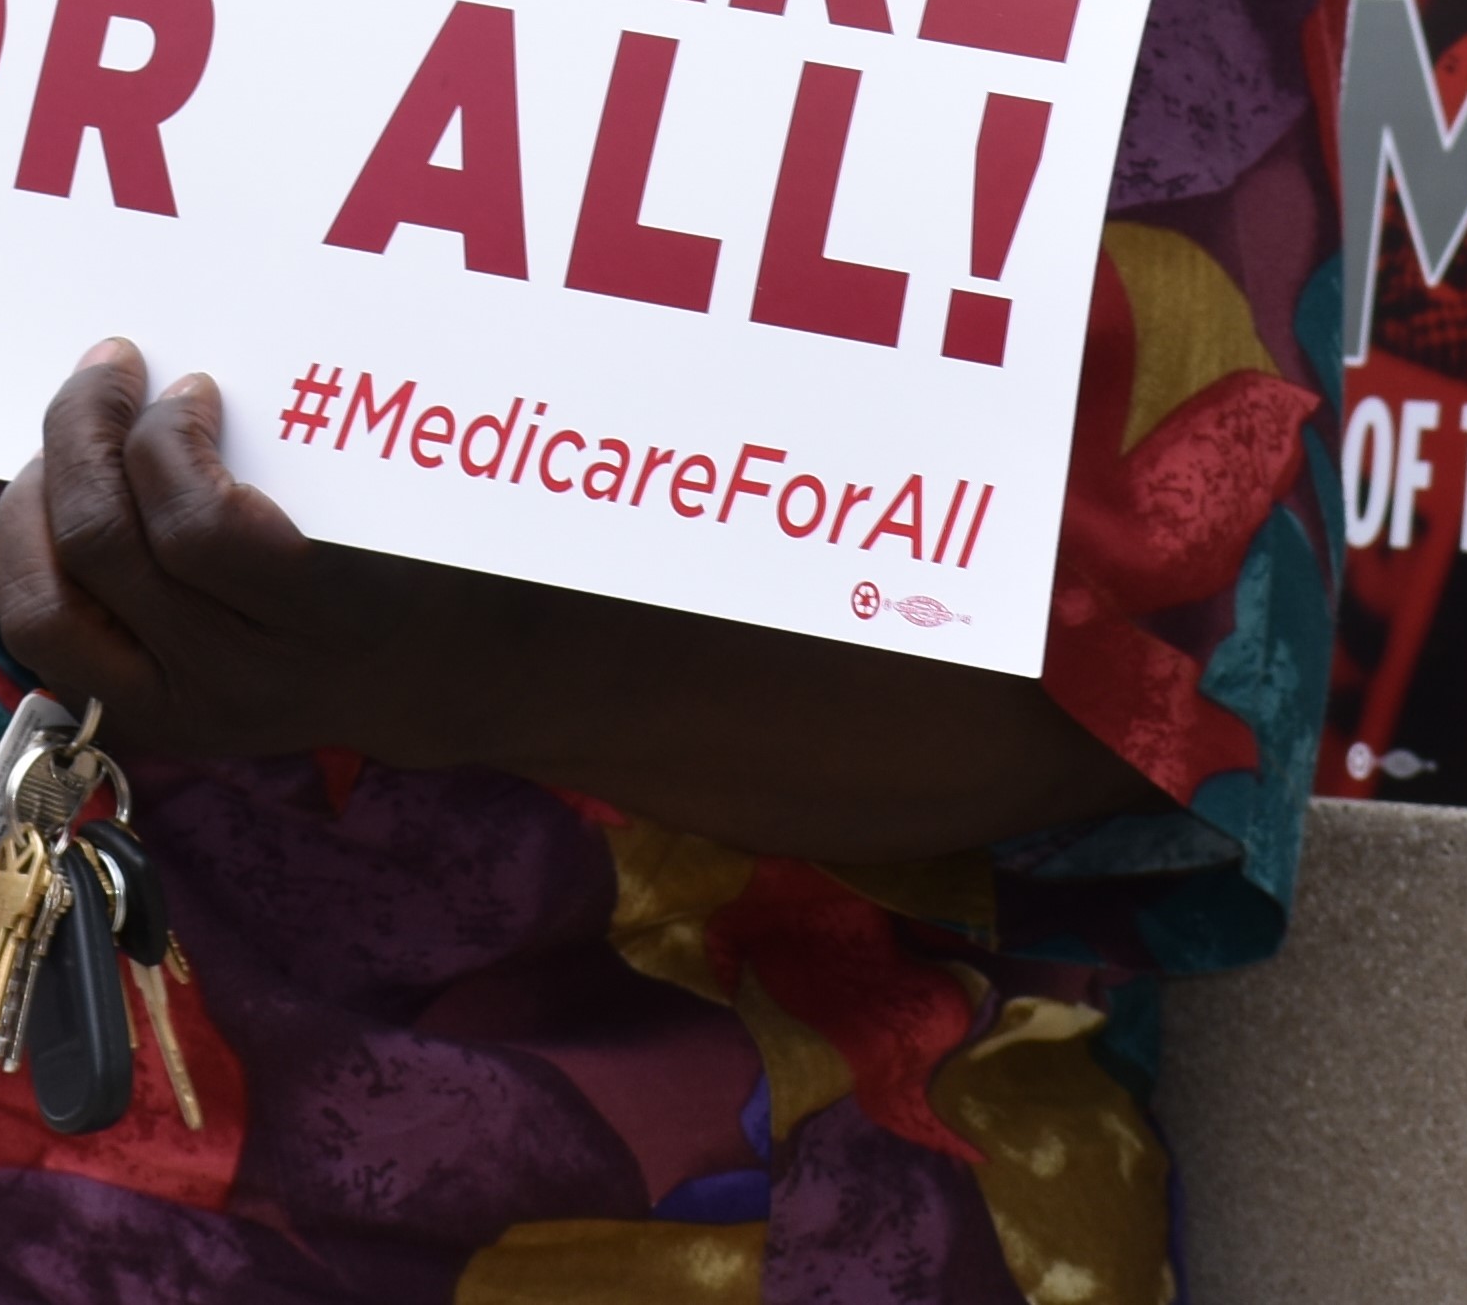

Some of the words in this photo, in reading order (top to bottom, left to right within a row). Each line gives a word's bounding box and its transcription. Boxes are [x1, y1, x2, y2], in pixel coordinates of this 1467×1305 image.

[322, 0, 1053, 368] ALL!
[279, 363, 994, 569] #MedicareForAll
[1342, 395, 1440, 549] OF
